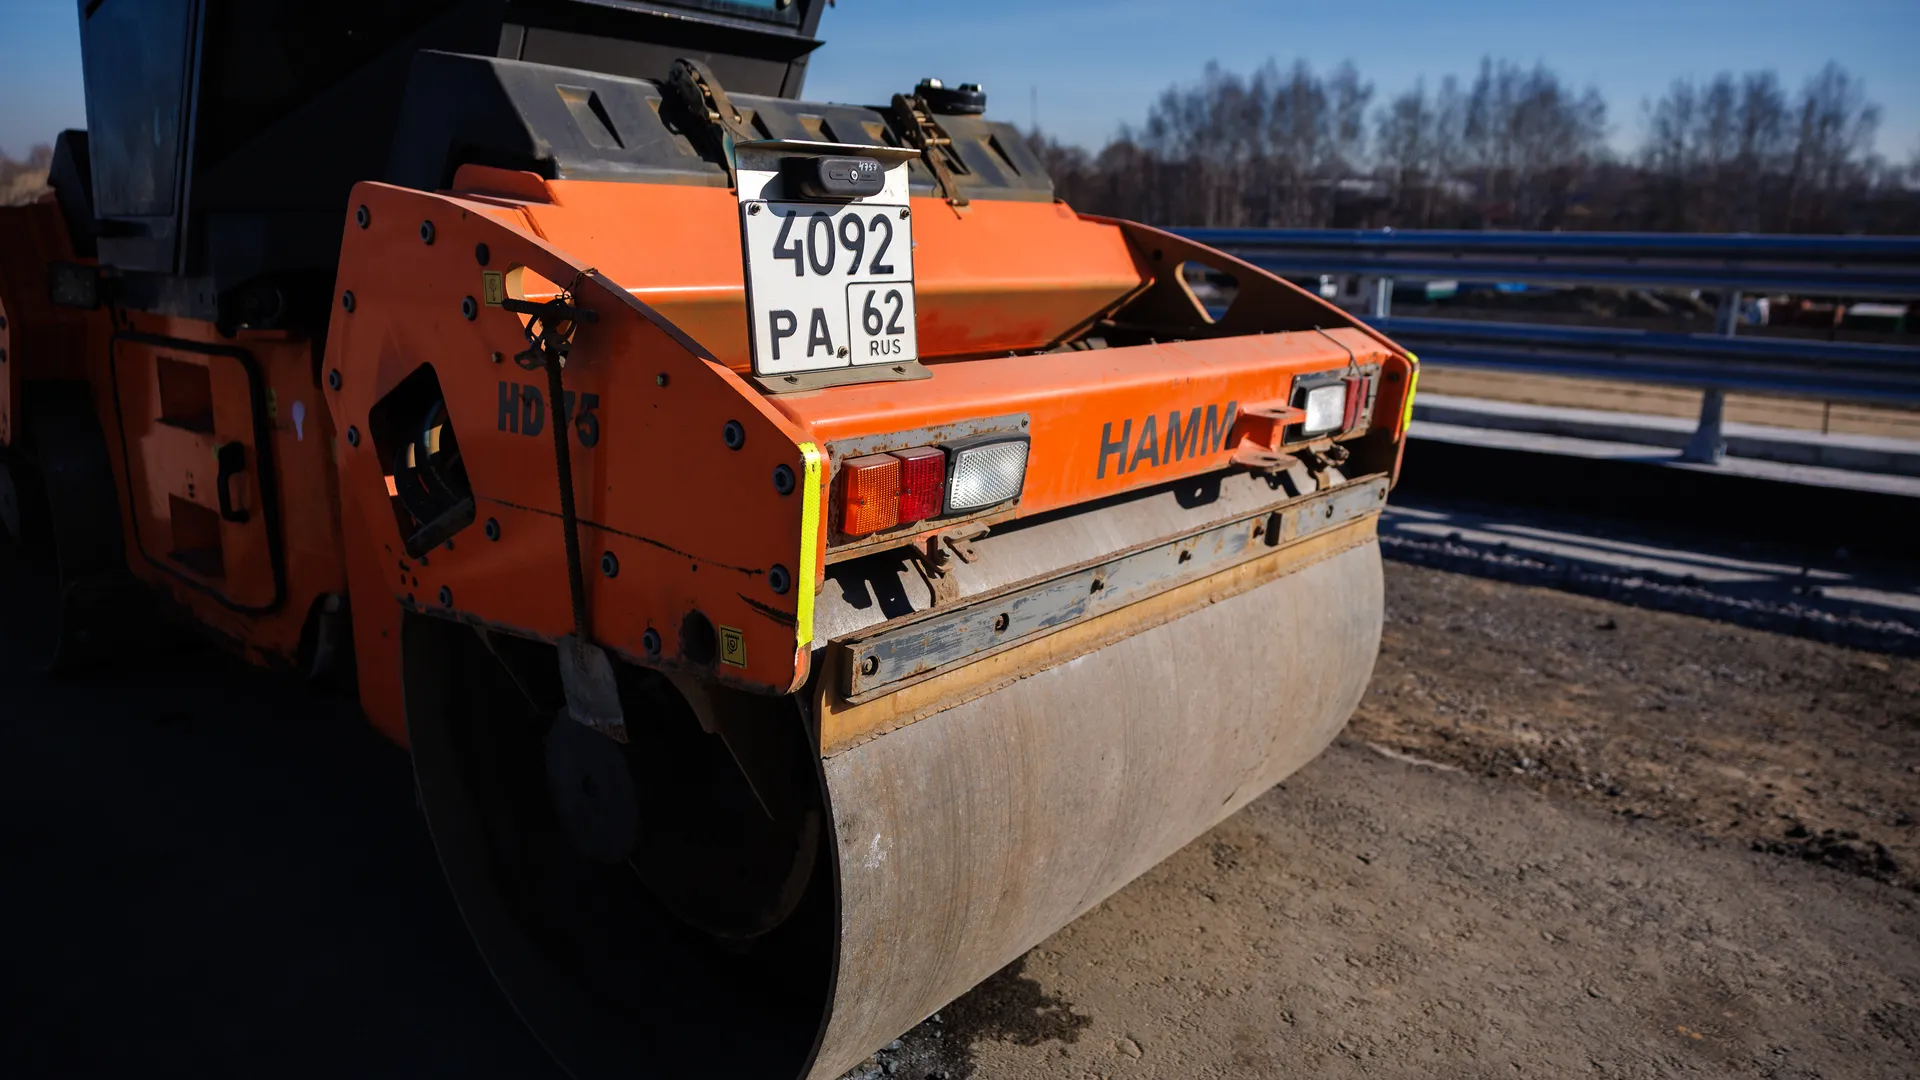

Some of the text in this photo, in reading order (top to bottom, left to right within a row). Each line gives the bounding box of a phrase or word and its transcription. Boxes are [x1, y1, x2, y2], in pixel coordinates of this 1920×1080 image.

[772, 210, 894, 277] 4092
[769, 307, 835, 360] PA
[862, 289, 905, 336] 62
[870, 338, 902, 356] RUS
[498, 381, 544, 437] HD
[1097, 400, 1238, 480] HAMM
